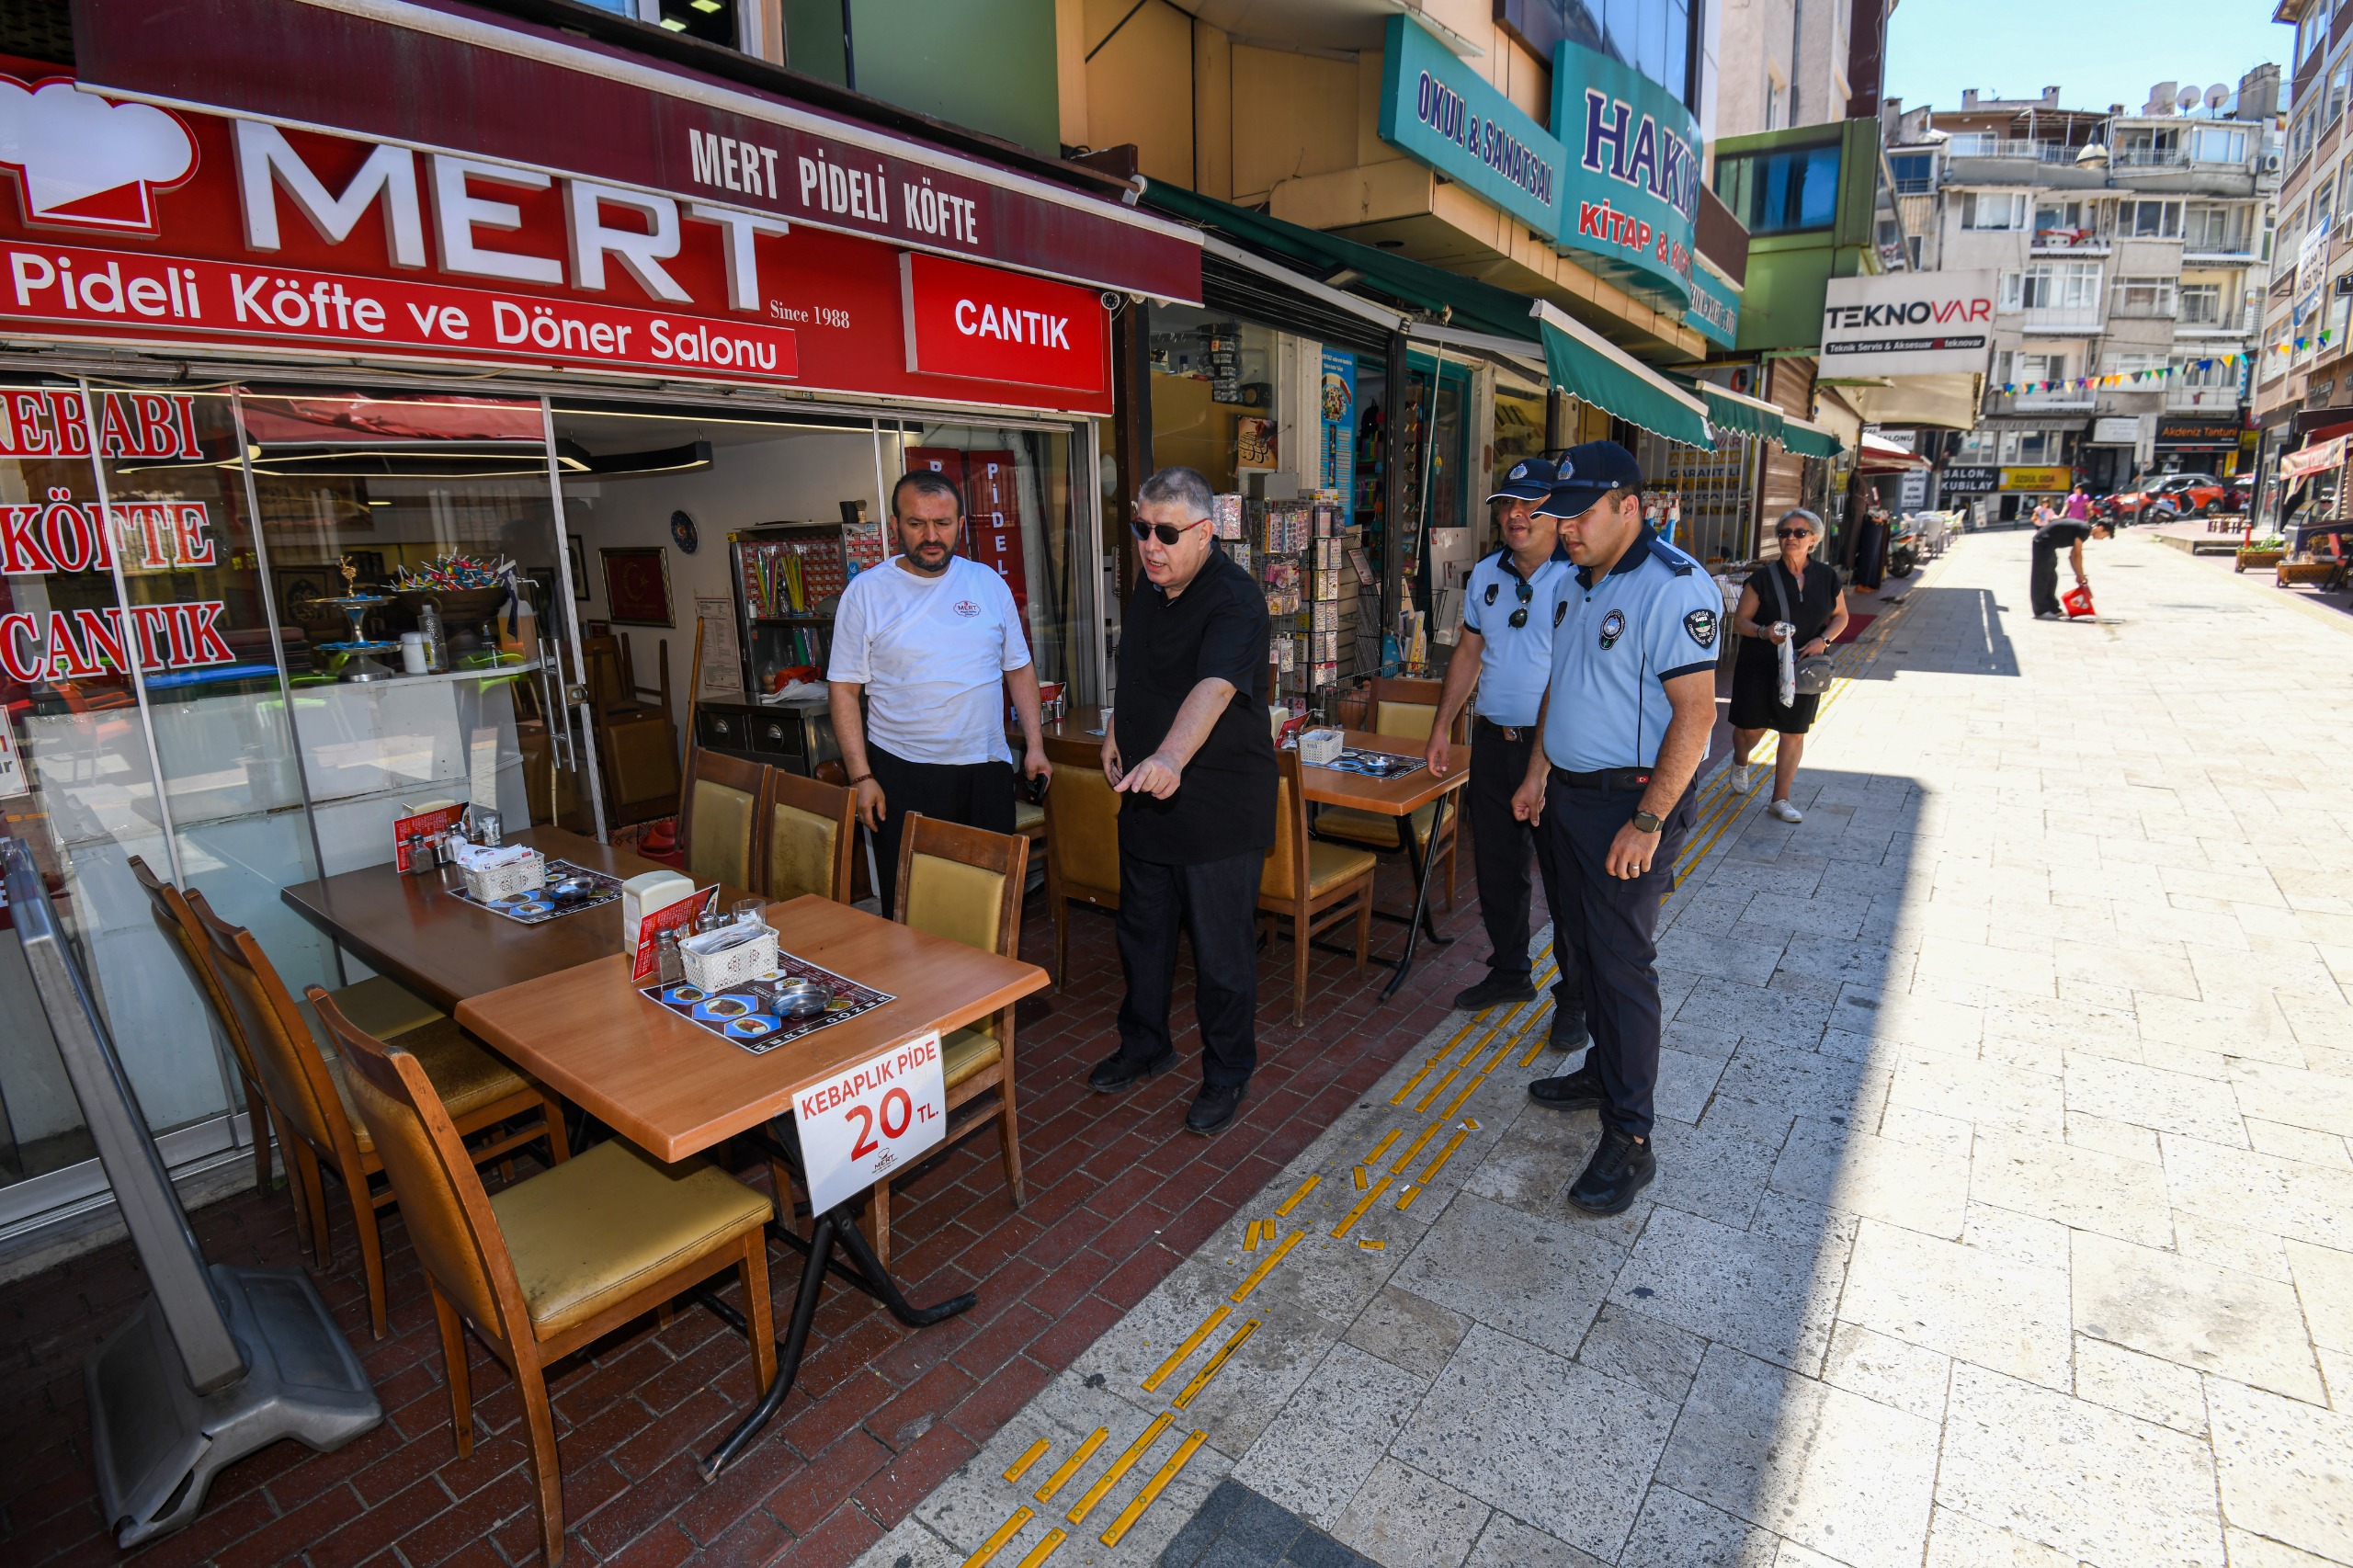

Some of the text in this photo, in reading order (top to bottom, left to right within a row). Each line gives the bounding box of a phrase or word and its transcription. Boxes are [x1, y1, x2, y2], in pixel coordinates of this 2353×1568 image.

[1417, 69, 1553, 208] OKUL & SANATSAL
[231, 118, 790, 312] MERT
[689, 129, 979, 245] MERT PİDELİ KÖFTE
[1578, 198, 1652, 253] KİTAP
[1654, 231, 1668, 265] &
[10, 251, 778, 370] Pideli Köfte ve Döner Salonu
[770, 300, 850, 329] Since 1988
[955, 299, 1071, 351] CANTIK
[1825, 298, 1992, 329] TEKNOVAR
[1830, 343, 1856, 353] Teknik
[1858, 342, 1882, 352] Servis
[1884, 341, 1891, 350] &
[1893, 340, 1933, 350] Aksesuar
[2162, 426, 2238, 437] Akdeniz Tantuni
[1942, 469, 1984, 478] SALON
[0, 487, 216, 576] KÖFTE
[0, 600, 236, 683] CANTIK
[801, 1040, 937, 1120] KEBAPLIK PİDE
[844, 1086, 913, 1163] 20
[874, 1153, 895, 1170] MERT
